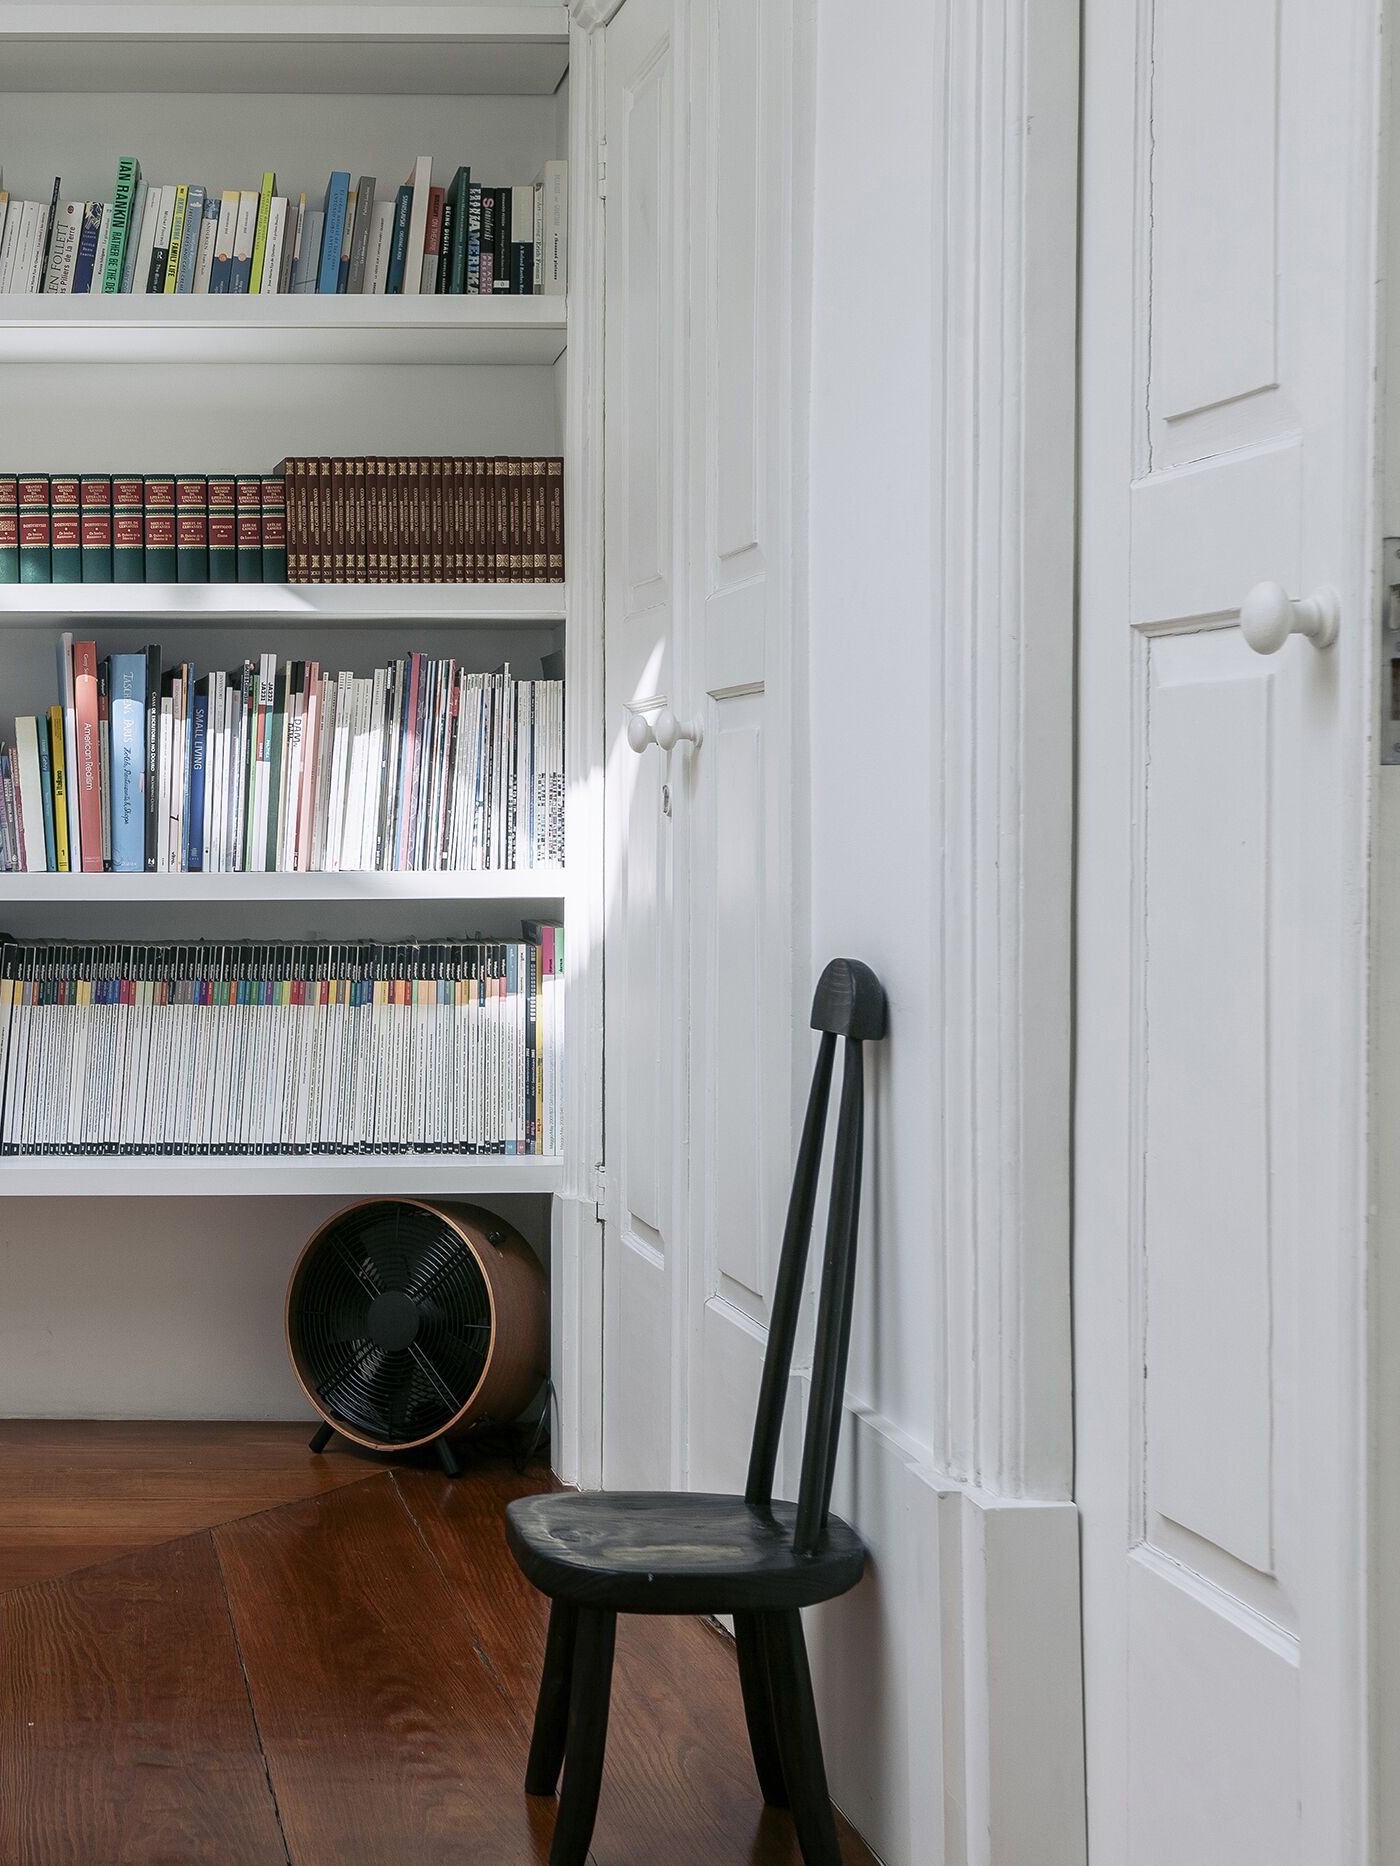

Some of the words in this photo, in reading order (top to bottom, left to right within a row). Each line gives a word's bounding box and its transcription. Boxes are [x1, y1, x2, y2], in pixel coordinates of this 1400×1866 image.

[117, 160, 133, 181] IAN
[111, 183, 130, 228] RANKIN
[443, 205, 451, 226] BEING
[65, 225, 76, 243] Terre
[108, 230, 122, 256] RATHER
[442, 228, 450, 255] DIGITAL
[50, 220, 68, 271] FOLLETT
[64, 244, 73, 252] la
[168, 241, 180, 263] FAMILY
[63, 252, 71, 262] de
[107, 257, 119, 267] BE
[59, 263, 71, 285] Piliers
[105, 267, 117, 281] THE
[167, 263, 176, 277] LIFE
[259, 681, 267, 701] JA231
[266, 681, 274, 702] JA232
[122, 718, 133, 743] PARIS
[194, 708, 205, 738] SMALL
[83, 723, 93, 760] American
[150, 743, 155, 752] NO
[193, 741, 203, 770] LIVING
[84, 760, 94, 791] Realism
[120, 806, 130, 824] Shops
